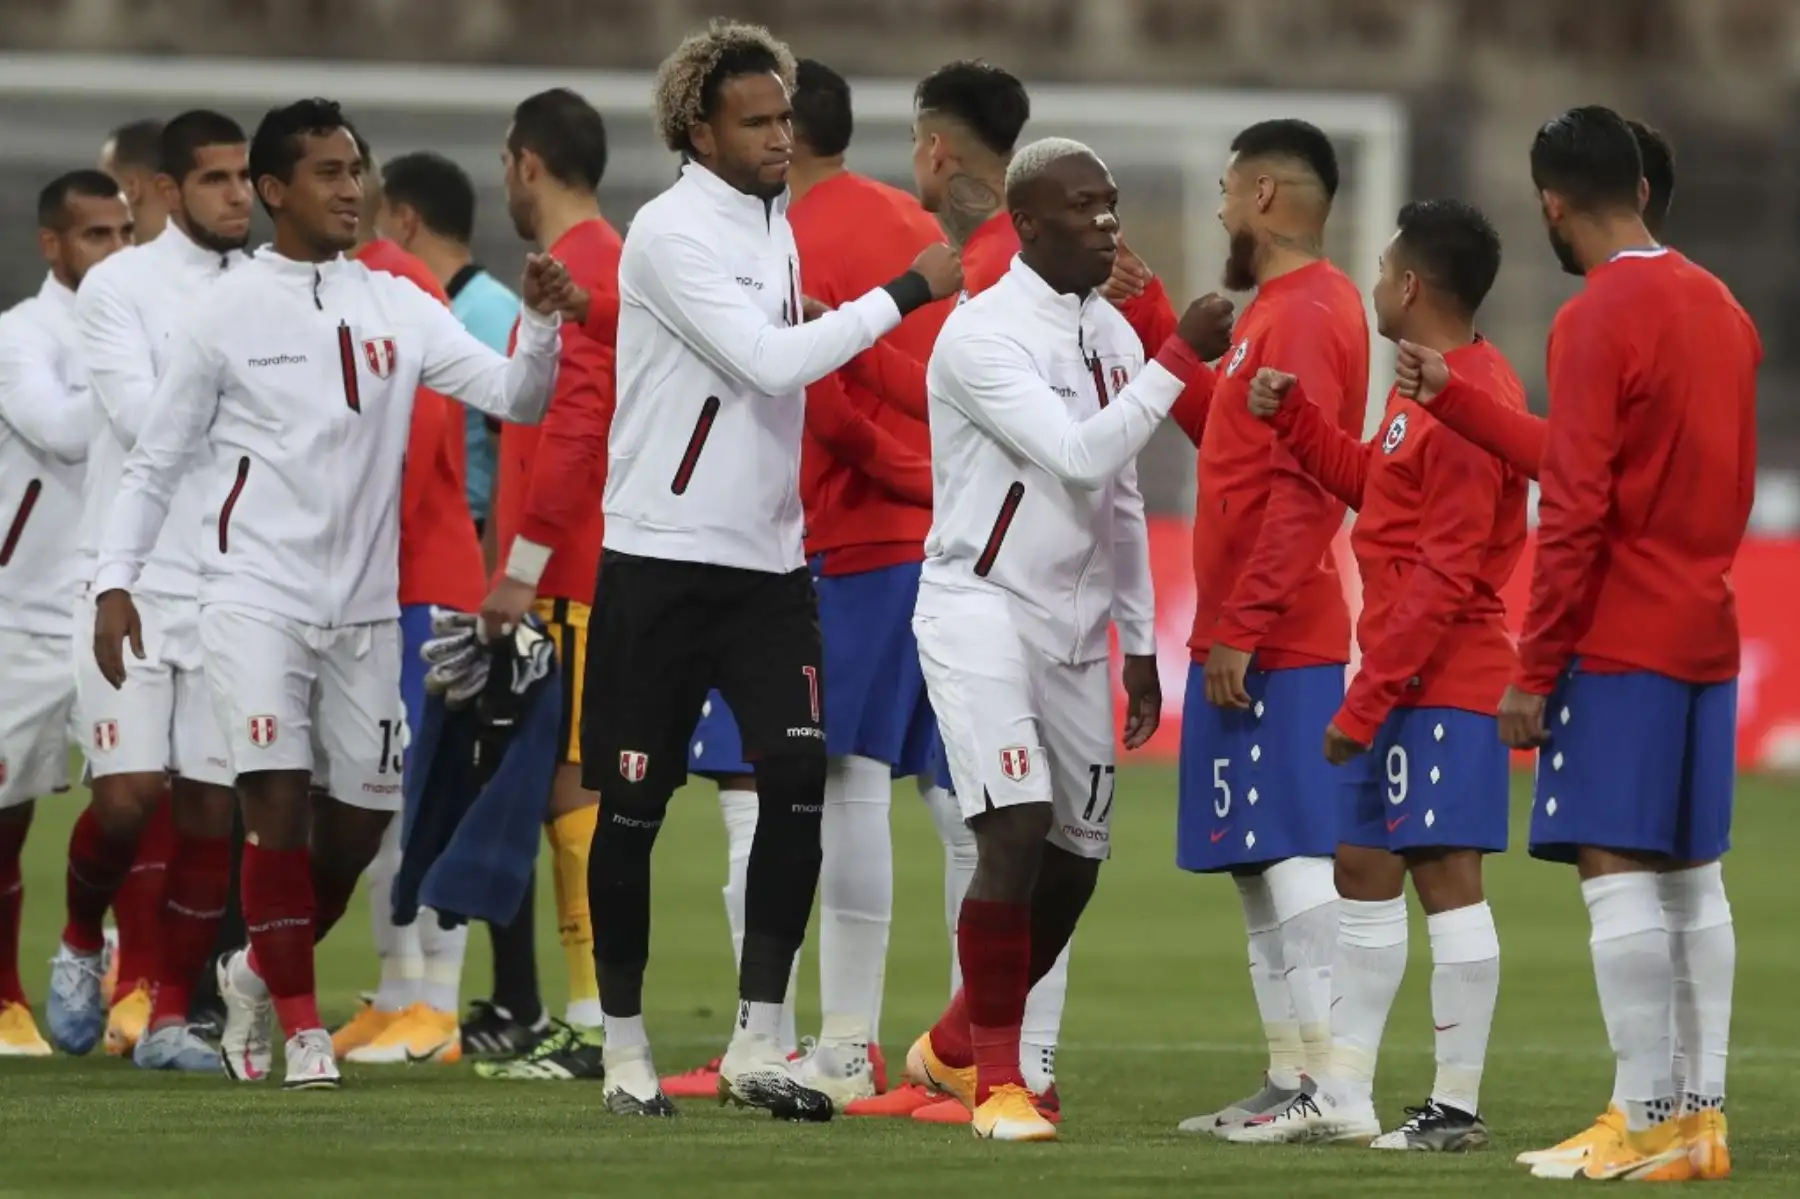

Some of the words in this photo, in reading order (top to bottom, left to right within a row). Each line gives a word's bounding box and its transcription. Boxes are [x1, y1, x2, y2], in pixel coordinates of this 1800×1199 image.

[247, 353, 307, 368] marathon
[802, 665, 820, 723] 1
[1082, 764, 1115, 823] 17
[1213, 758, 1231, 818] 5
[1386, 744, 1408, 805] 9
